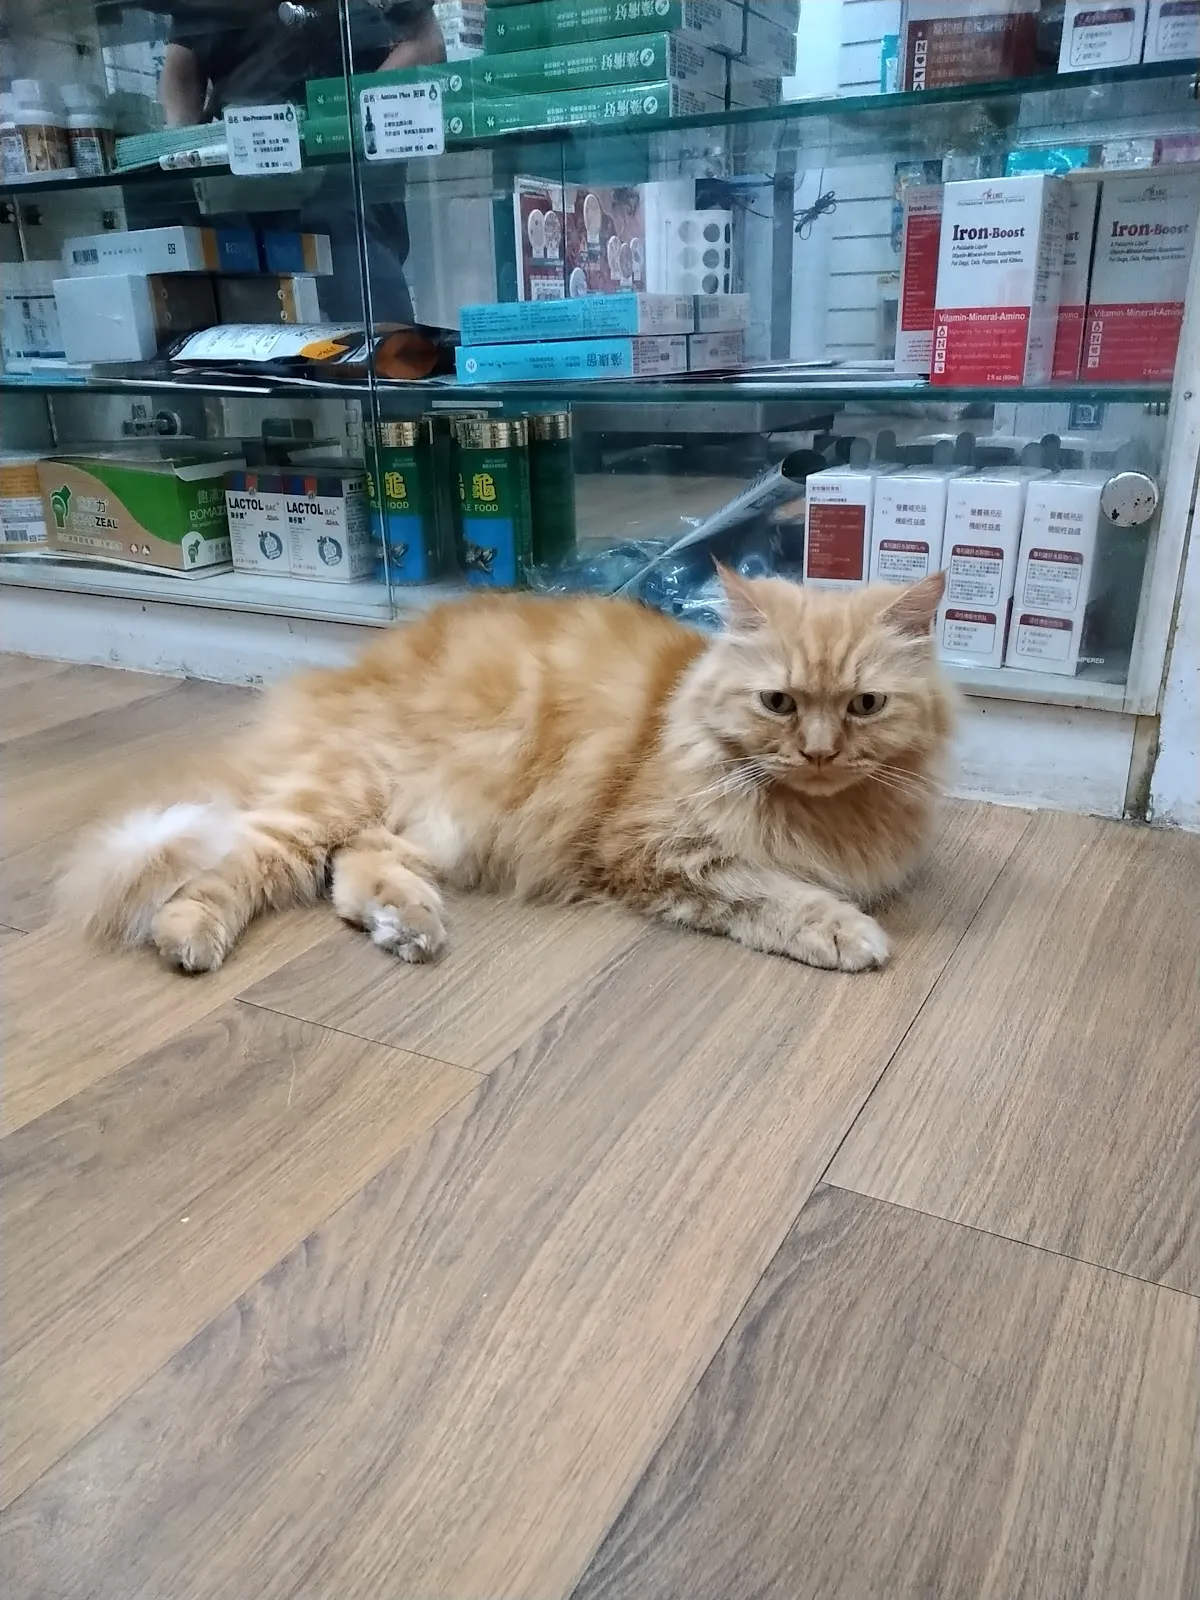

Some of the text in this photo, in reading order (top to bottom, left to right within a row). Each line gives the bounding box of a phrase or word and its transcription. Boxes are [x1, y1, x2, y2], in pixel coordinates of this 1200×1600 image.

[952, 224, 1025, 241] Iron-Boost
[1111, 220, 1190, 237] Iron-Boost
[938, 311, 1025, 322] Vitamin-Mineral-Amino
[1094, 307, 1180, 318] Vitamin-Mineral-Amin
[228, 497, 264, 511] LACTOL
[286, 501, 337, 516] LACTOL BAC
[474, 503, 499, 512] FOOD
[896, 503, 927, 512] 營養補充品
[970, 508, 1002, 518] 營養補充品
[1049, 511, 1083, 521] 營養補充品
[894, 517, 926, 526] 機能性益處
[969, 522, 1001, 532] 機能性益處
[1047, 525, 1082, 536] 機能性益處
